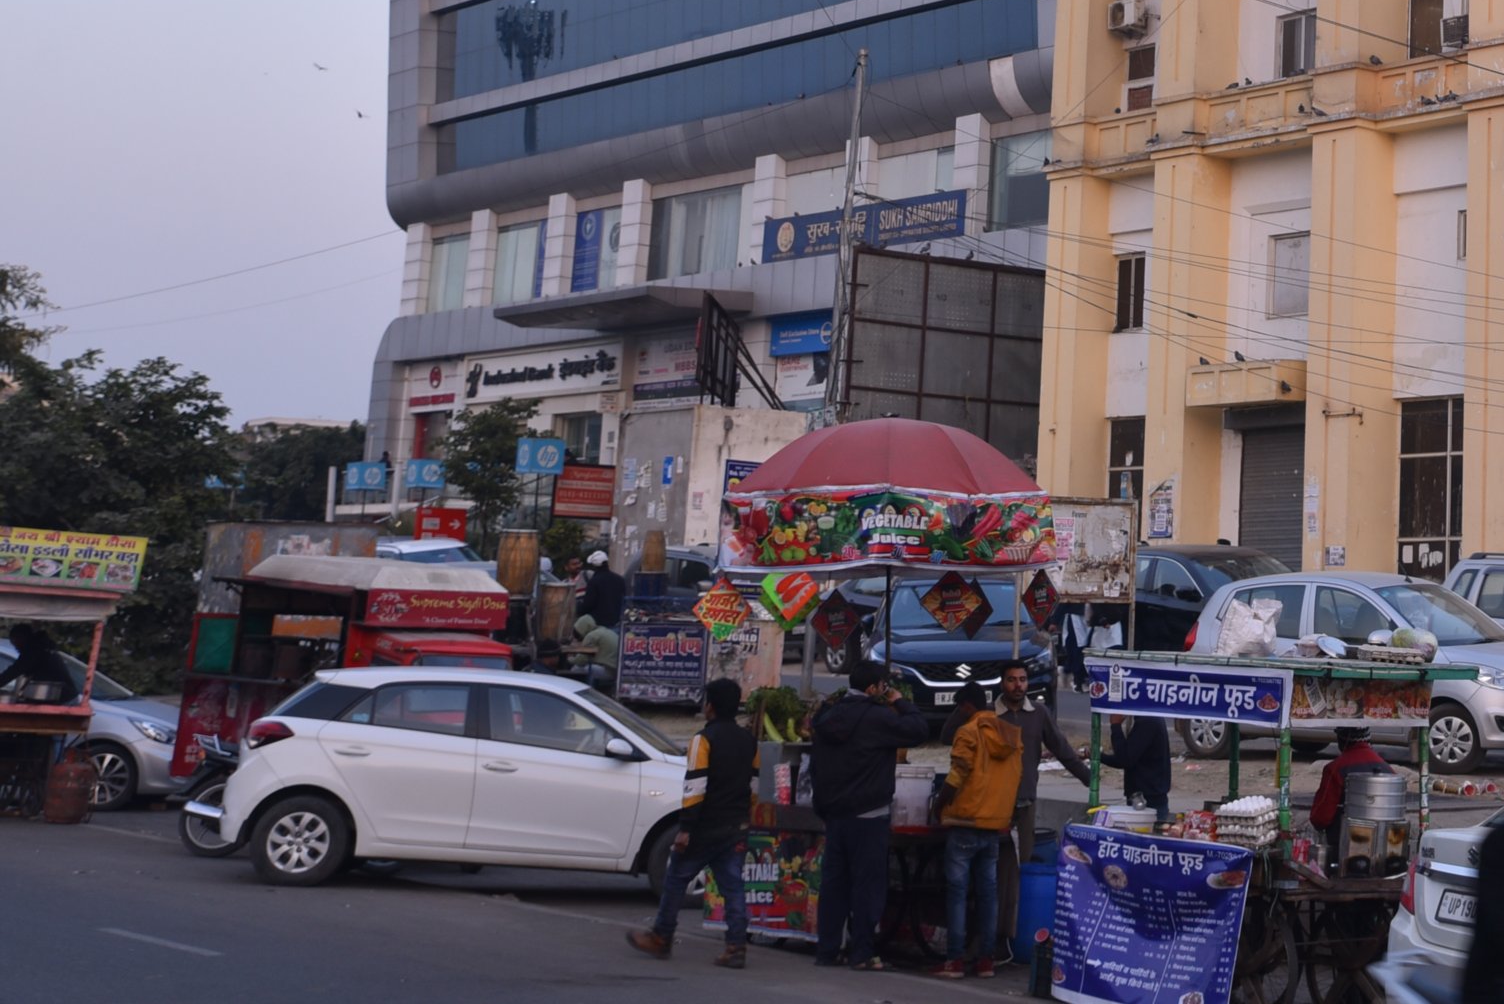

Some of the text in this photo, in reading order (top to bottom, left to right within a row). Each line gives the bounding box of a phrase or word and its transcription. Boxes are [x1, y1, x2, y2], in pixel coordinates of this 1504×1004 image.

[880, 199, 958, 230] SUKH SAMRIDDHI
[539, 445, 558, 468] hp
[861, 514, 928, 530] VEGETABLE
[867, 532, 921, 545] Juice
[410, 595, 455, 610] Supreme
[483, 597, 507, 610] Dosa
[1146, 674, 1220, 707] चाइनीज
[1224, 684, 1257, 718] फूड
[1098, 836, 1204, 875] हॉट चाइनीज फूड
